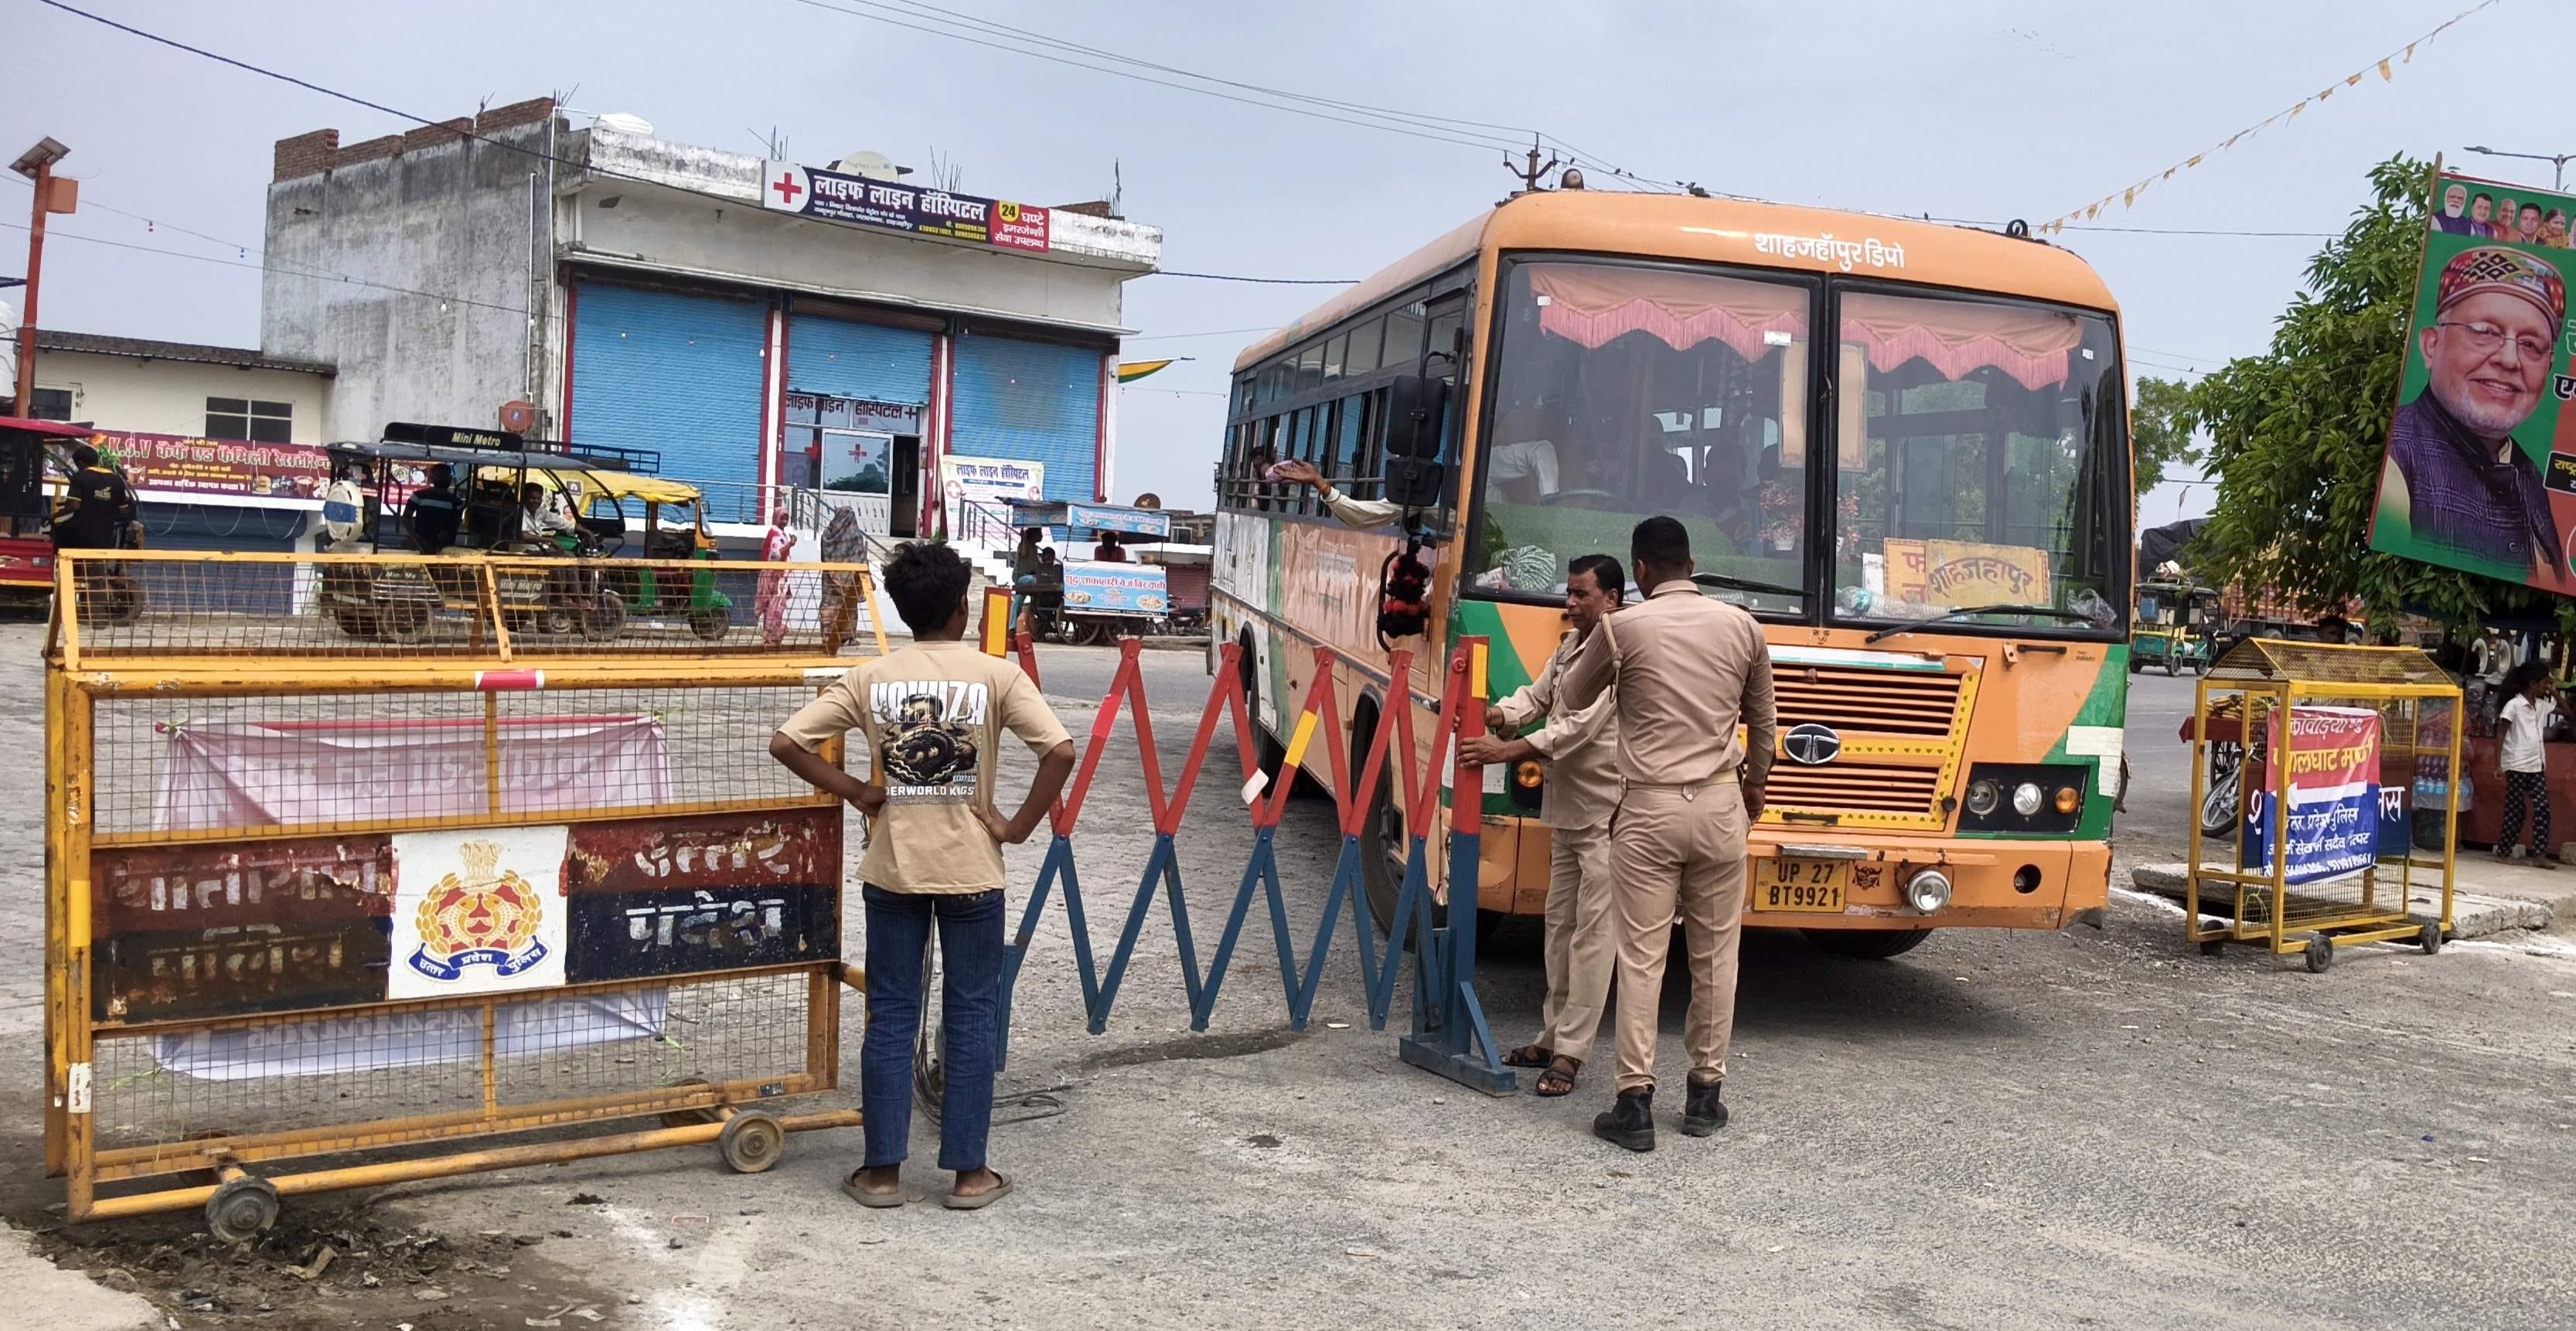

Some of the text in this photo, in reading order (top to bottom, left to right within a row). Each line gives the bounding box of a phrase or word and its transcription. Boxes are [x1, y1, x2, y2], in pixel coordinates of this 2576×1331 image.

[814, 175, 986, 221] लाइफ लाइन हॉस्पिटल
[1001, 204, 1016, 217] 24
[1021, 211, 1044, 225] घण्टे
[1863, 237, 1905, 268] डिपो
[451, 432, 501, 447] Mini Metro
[108, 437, 152, 458] K.S.V
[217, 444, 271, 466] फैमिली
[956, 464, 976, 475] लाइफ
[979, 465, 998, 478] लाइन
[1778, 863, 1834, 883] UP 27
[1770, 885, 1838, 907] BT9921
[419, 947, 542, 977] उत्तर प्रदेश पुलिस
